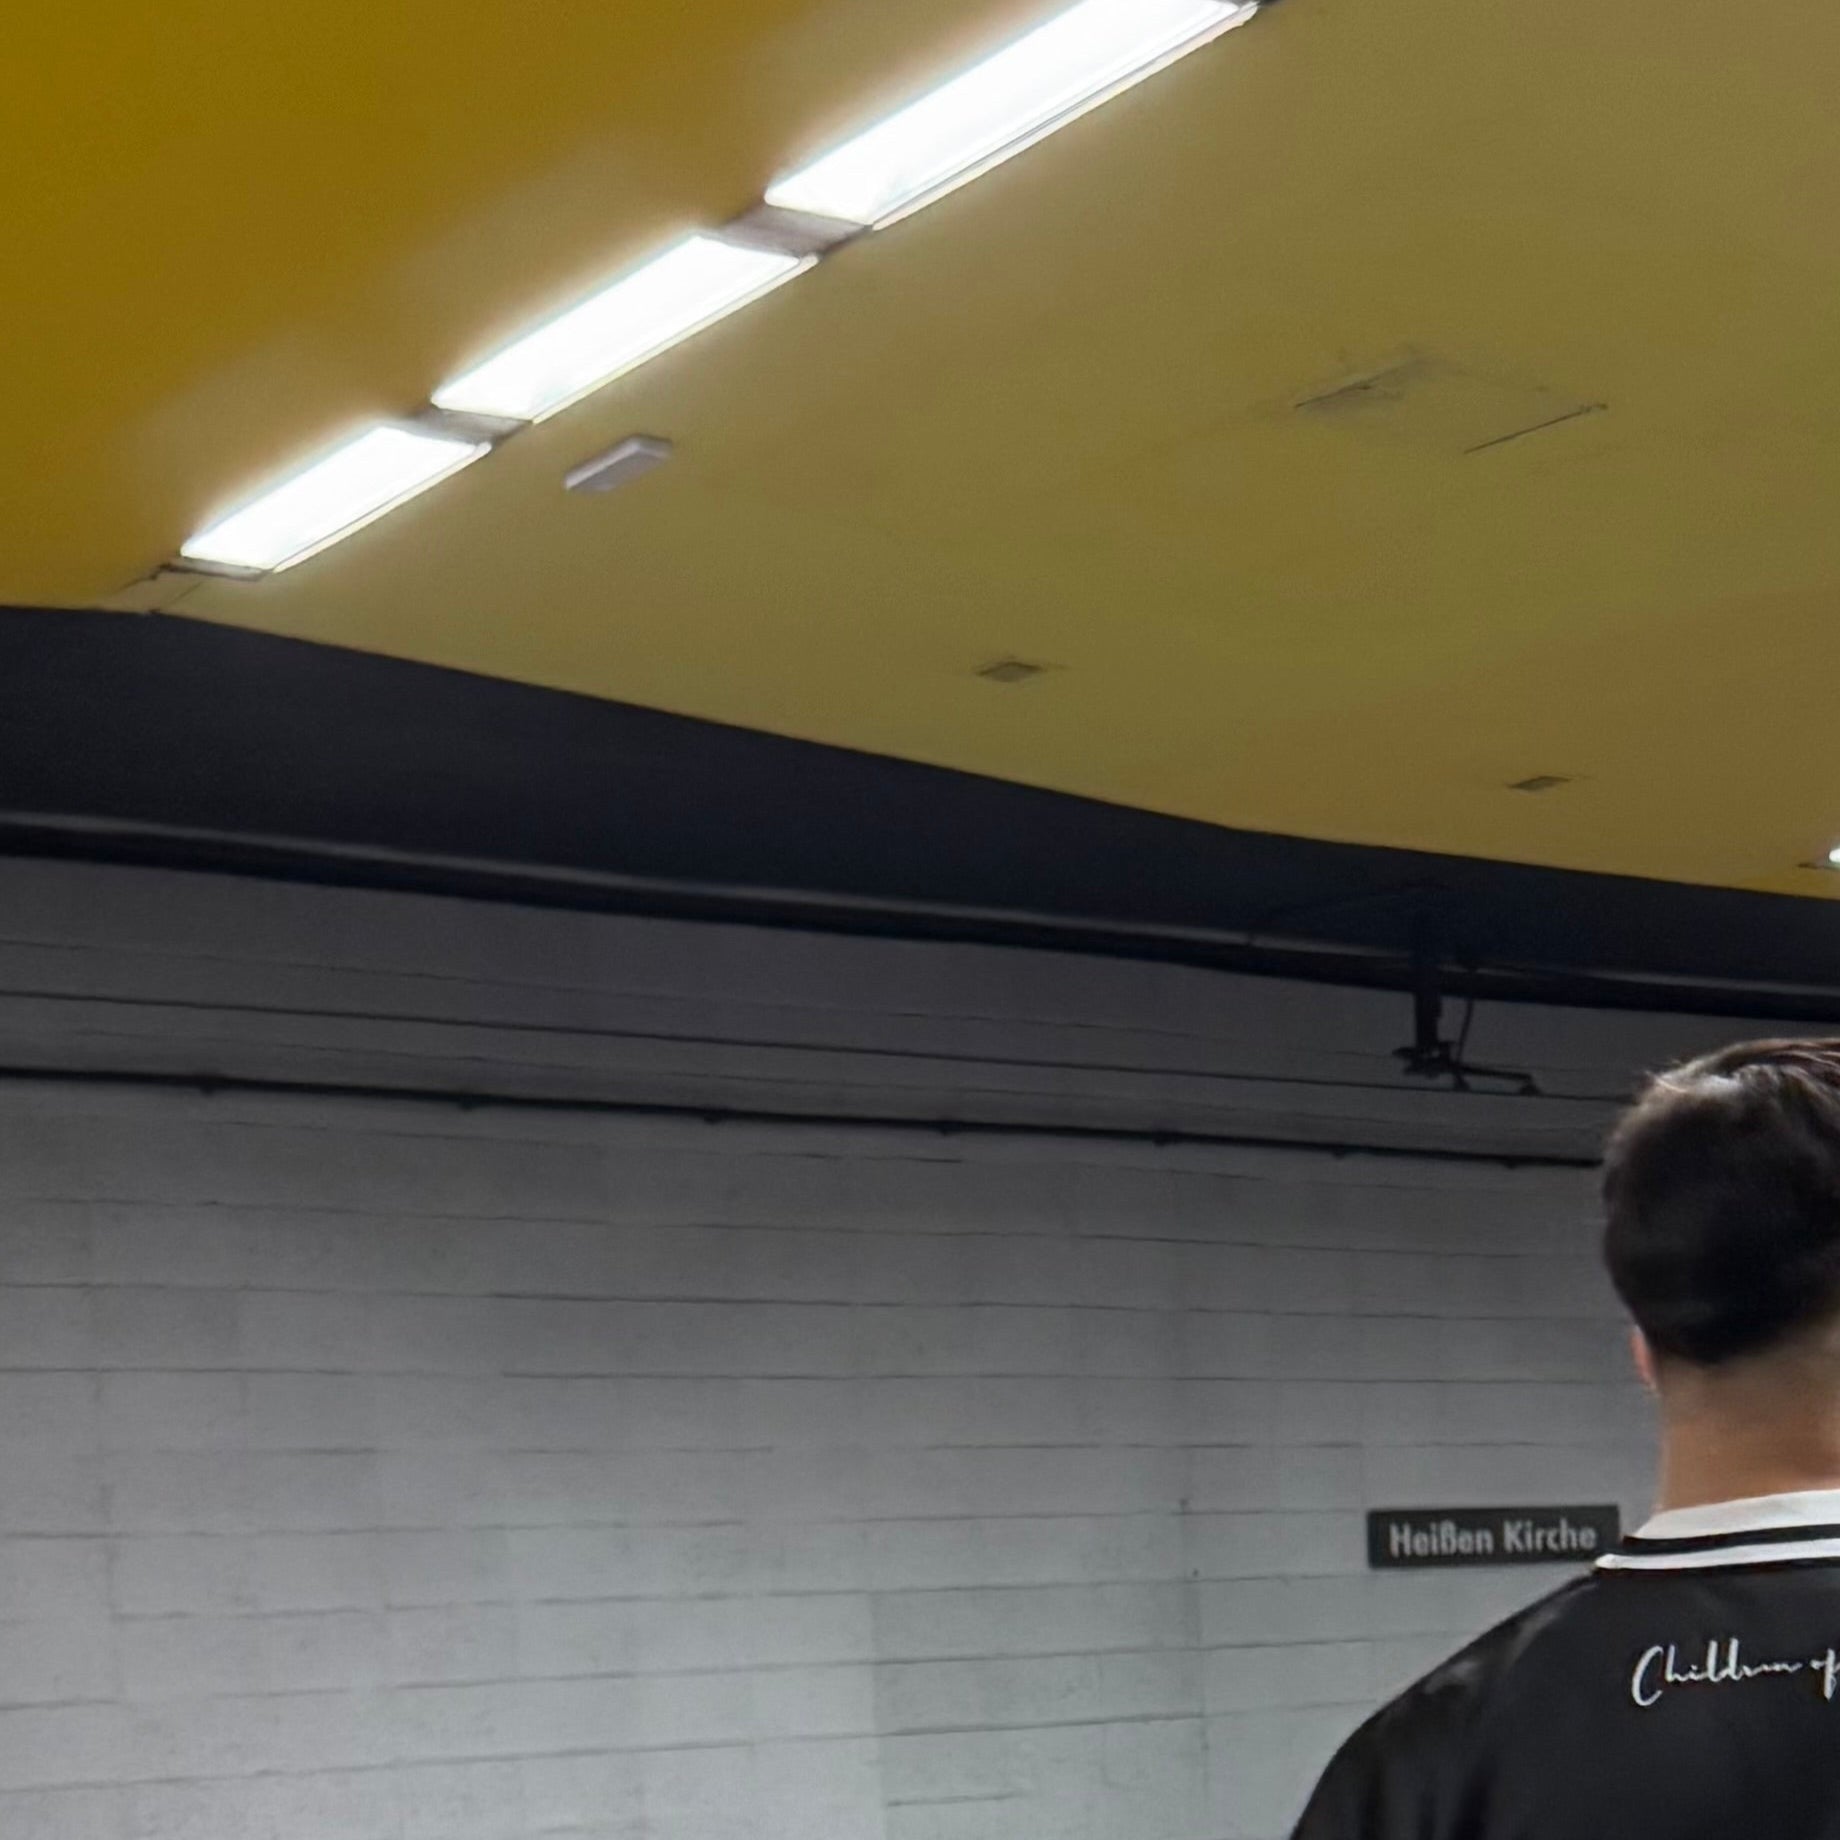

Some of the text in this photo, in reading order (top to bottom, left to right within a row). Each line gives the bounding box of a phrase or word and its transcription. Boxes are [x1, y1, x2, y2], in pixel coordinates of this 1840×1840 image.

[1388, 1516, 1597, 1558] Heißen Kirche
[1631, 1637, 1803, 1707] Children
